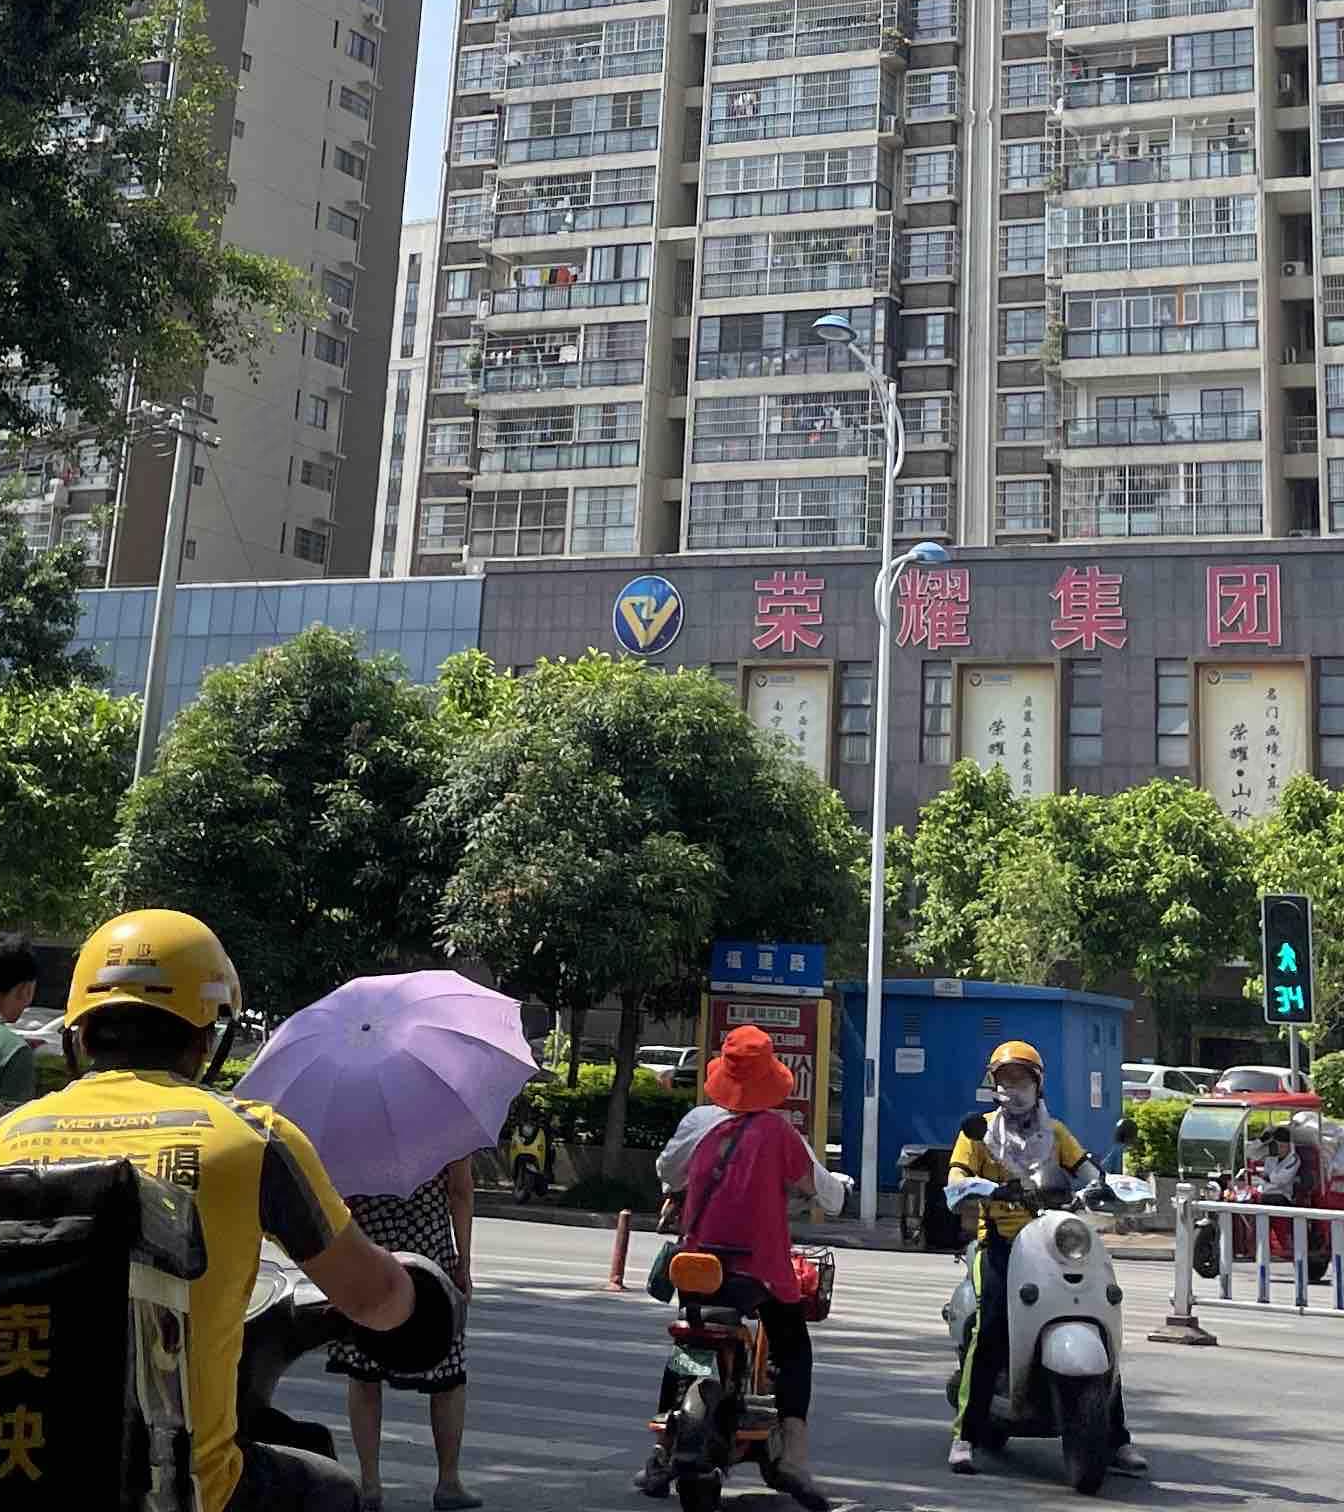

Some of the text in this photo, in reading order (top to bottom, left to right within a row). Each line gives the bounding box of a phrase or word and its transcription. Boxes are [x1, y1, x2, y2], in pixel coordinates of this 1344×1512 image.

[752, 565, 1283, 652] 荣耀集团
[1274, 985, 1305, 1014] 34
[56, 1115, 158, 1130] MEITUAN
